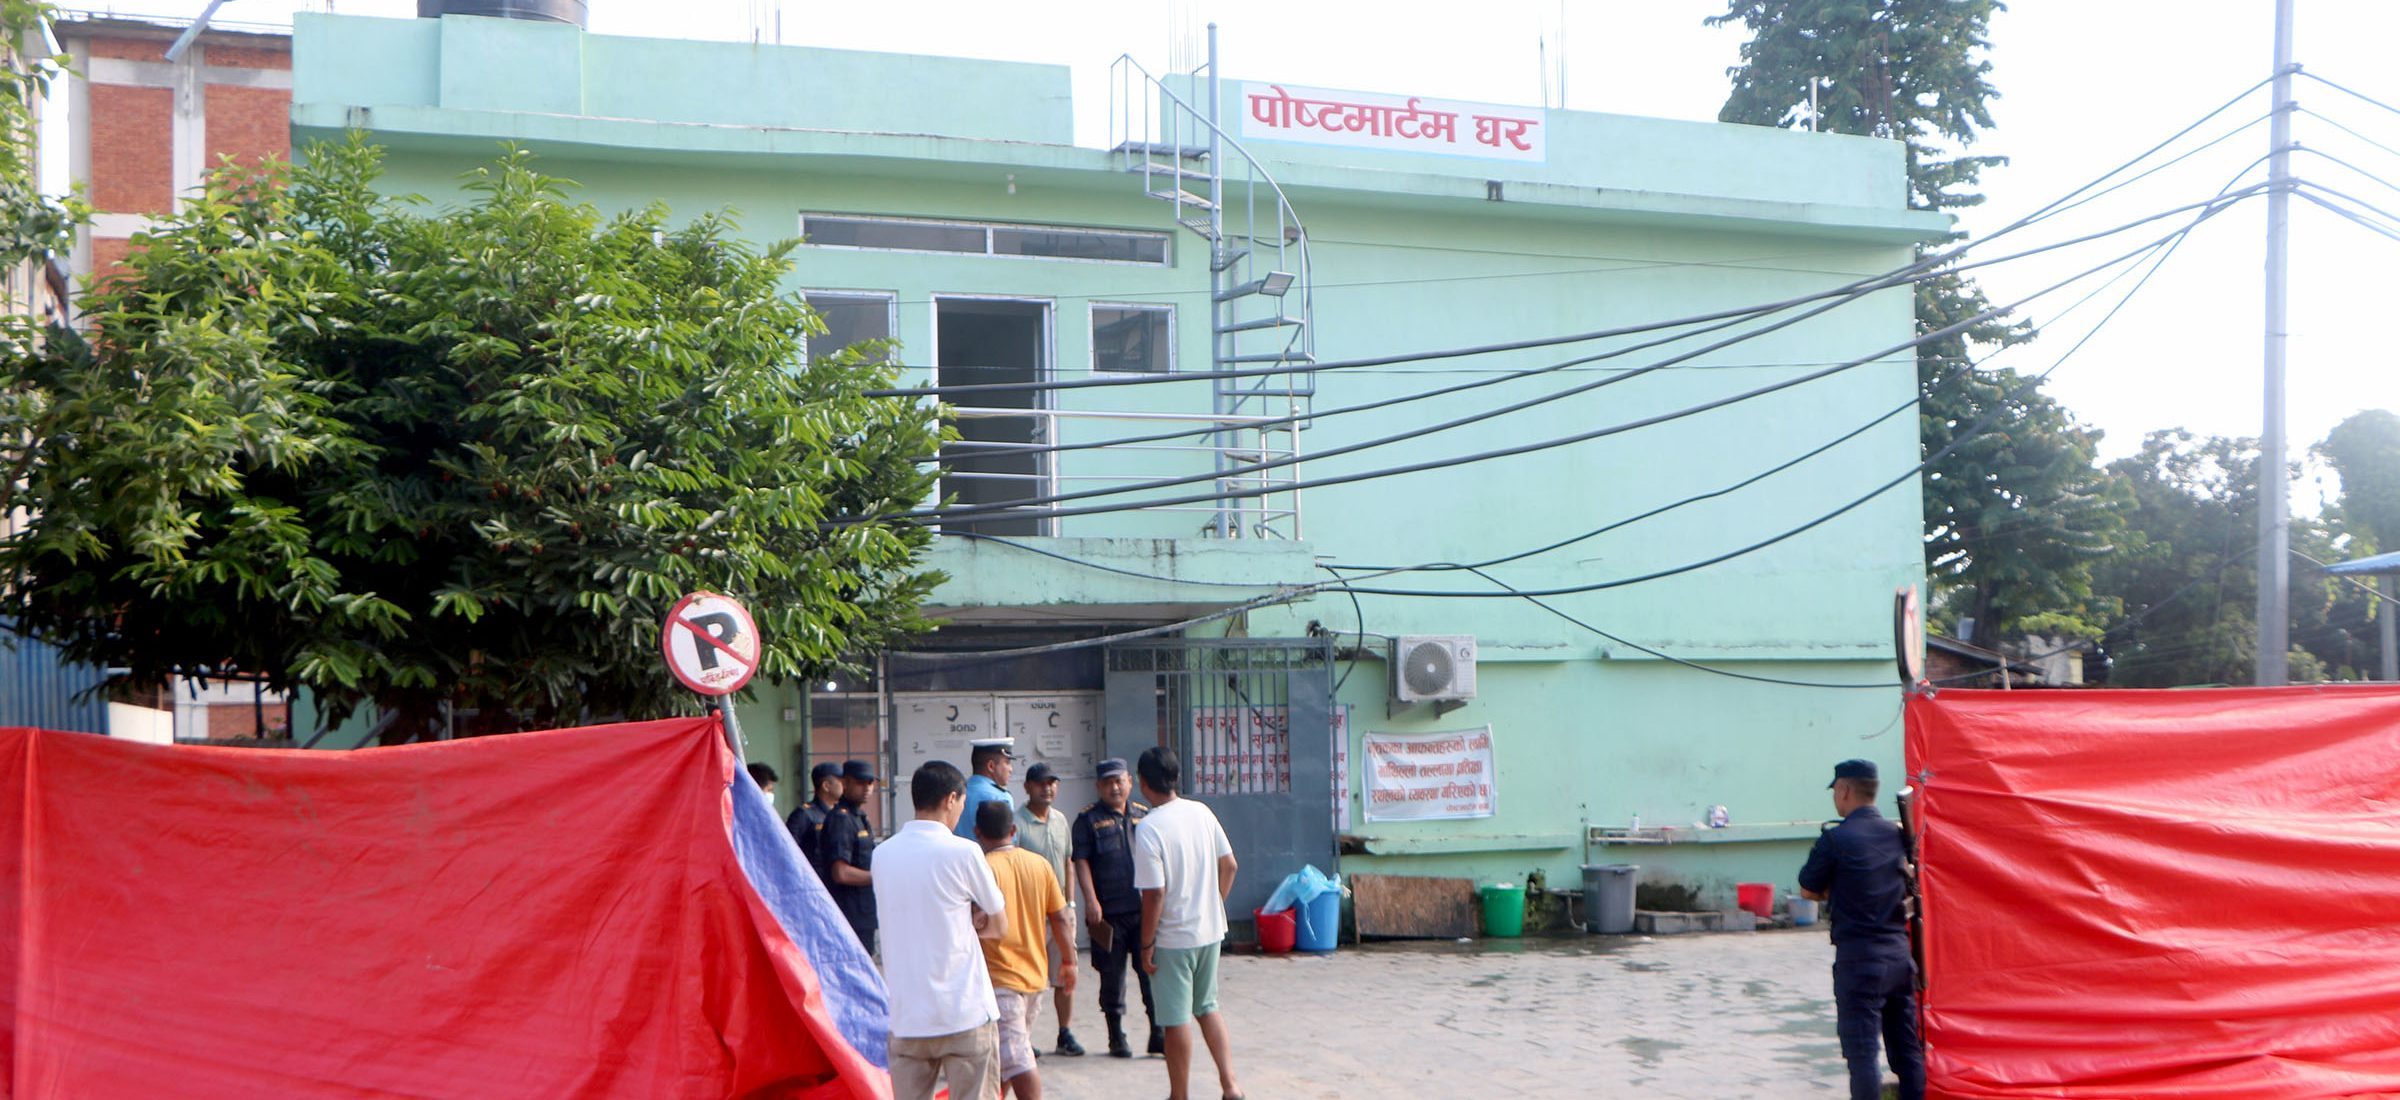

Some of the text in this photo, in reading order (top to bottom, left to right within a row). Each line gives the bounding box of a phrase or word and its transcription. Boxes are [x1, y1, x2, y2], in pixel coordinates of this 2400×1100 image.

[1248, 84, 1538, 151] पोष्टमार्टम घर
[689, 612, 738, 671] P
